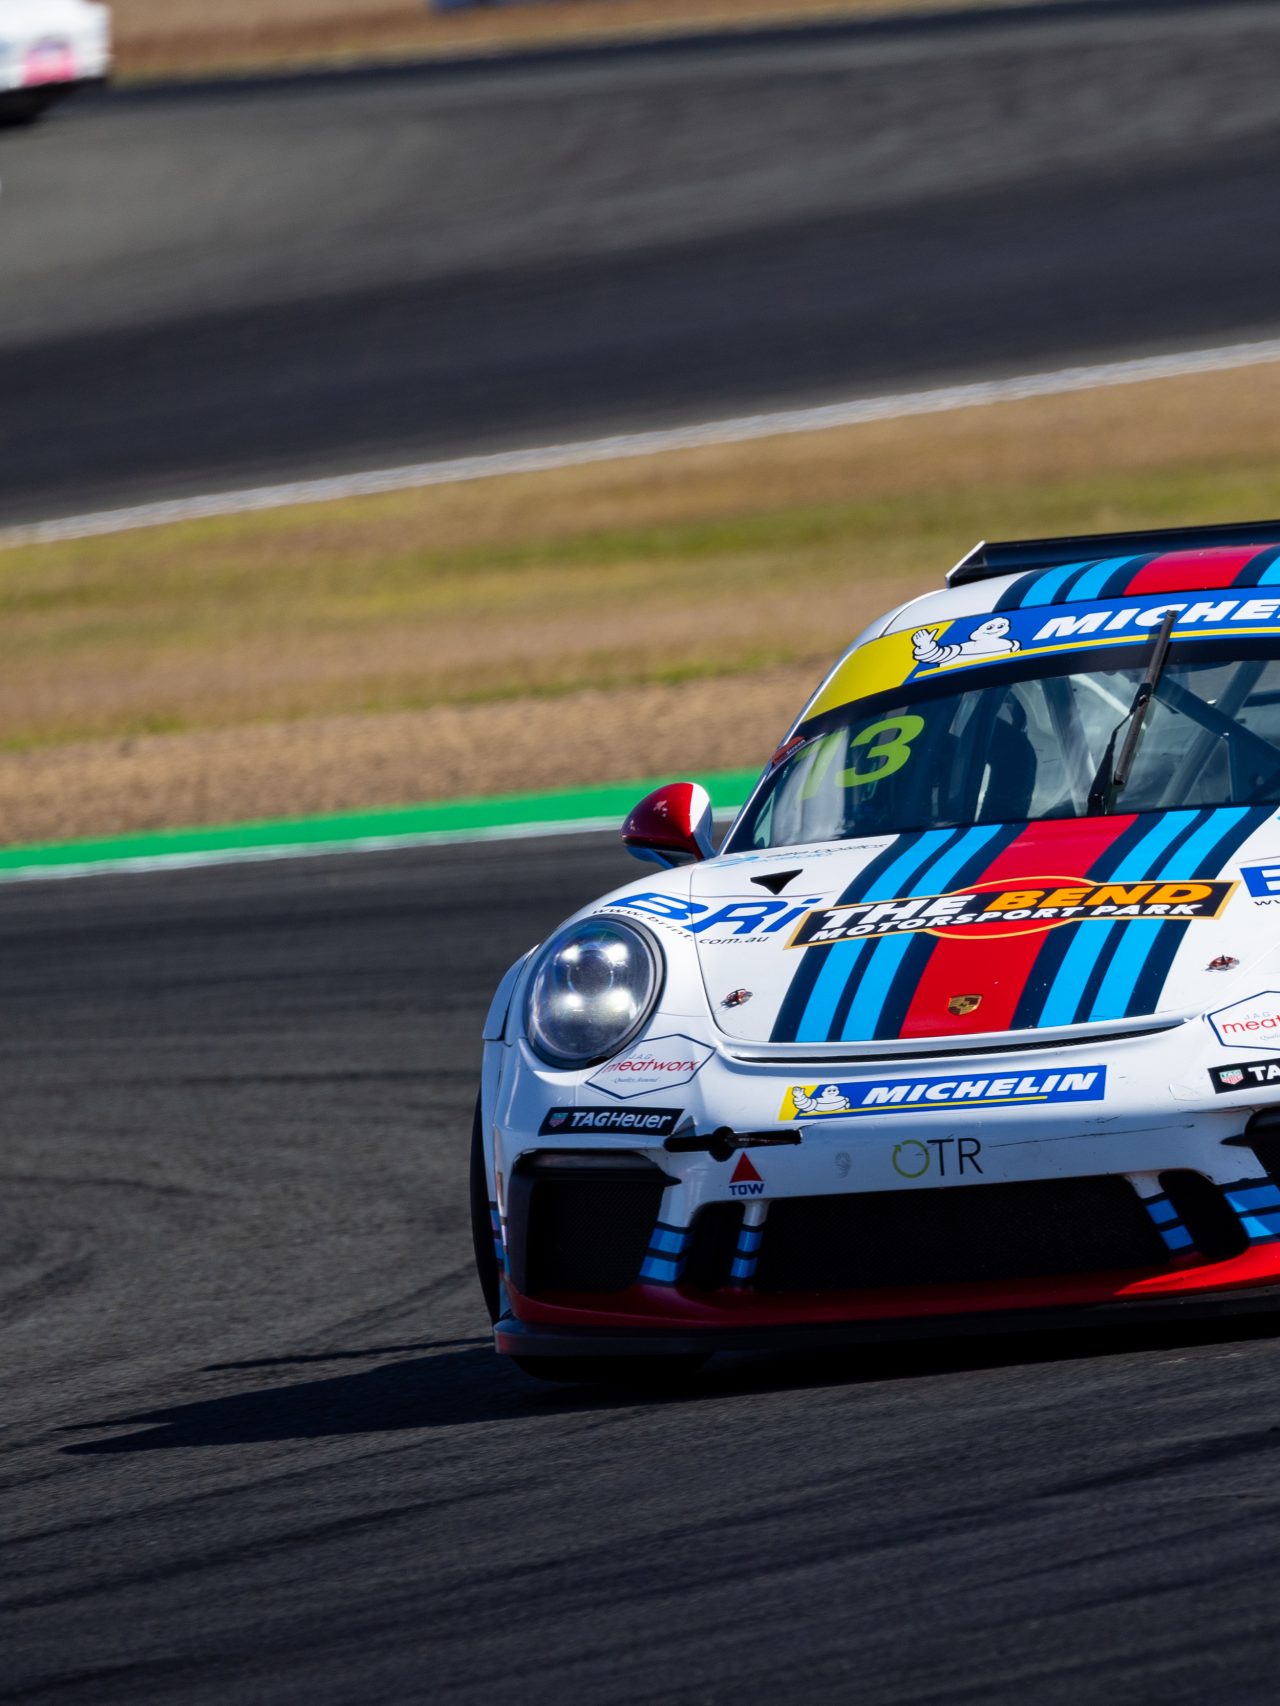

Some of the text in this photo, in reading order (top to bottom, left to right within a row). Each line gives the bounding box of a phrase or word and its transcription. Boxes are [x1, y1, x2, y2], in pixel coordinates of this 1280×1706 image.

[808, 903, 1204, 943] MOTORSPORT PARK
[819, 884, 1213, 931] THE BEND
[602, 1058, 701, 1074] meatworx
[860, 1072, 1099, 1106] MICHELIN
[892, 1137, 984, 1178] OTR
[729, 1183, 765, 1196] TOW
